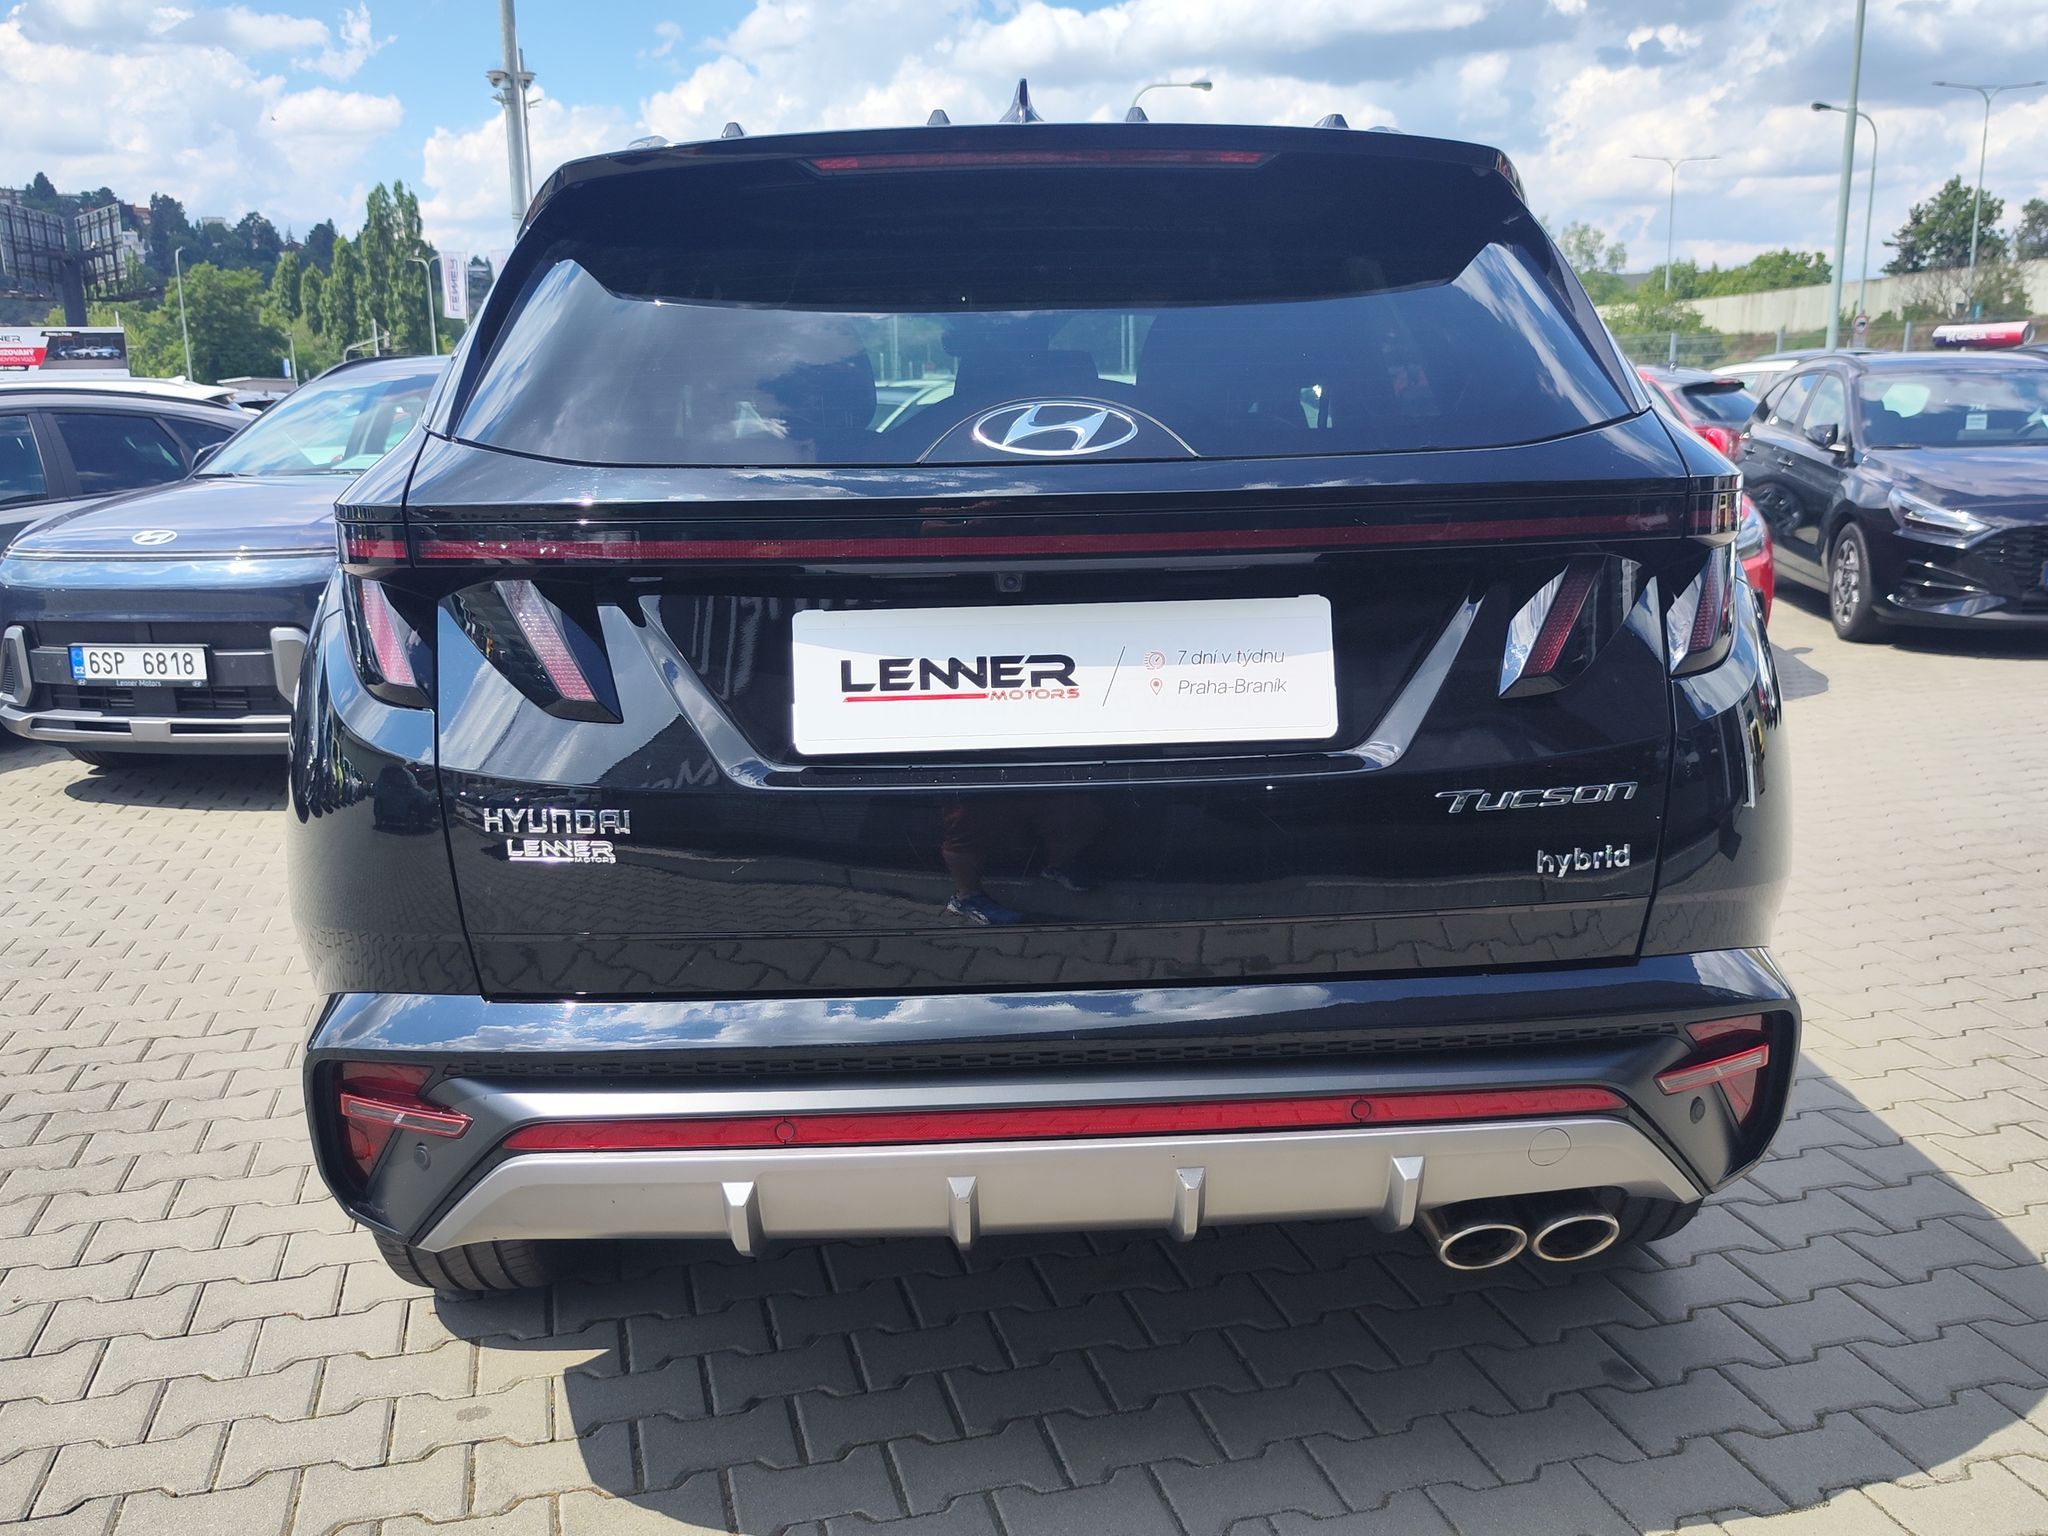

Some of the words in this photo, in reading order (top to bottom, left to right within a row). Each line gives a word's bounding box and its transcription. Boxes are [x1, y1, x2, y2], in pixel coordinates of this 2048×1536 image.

[88, 651, 125, 675] 6SP
[142, 651, 195, 676] 6818
[1177, 650, 1187, 665] 7
[1191, 649, 1219, 665] dní
[1221, 653, 1233, 665] v
[1237, 648, 1285, 667] týdnu
[841, 654, 1080, 691] LENNER
[989, 687, 1081, 702] MOTORS
[1178, 676, 1288, 695] Praha-Braník
[483, 807, 632, 835] HYUNDAI
[506, 839, 616, 857] LENNER
[1536, 844, 1632, 878] hybrid
